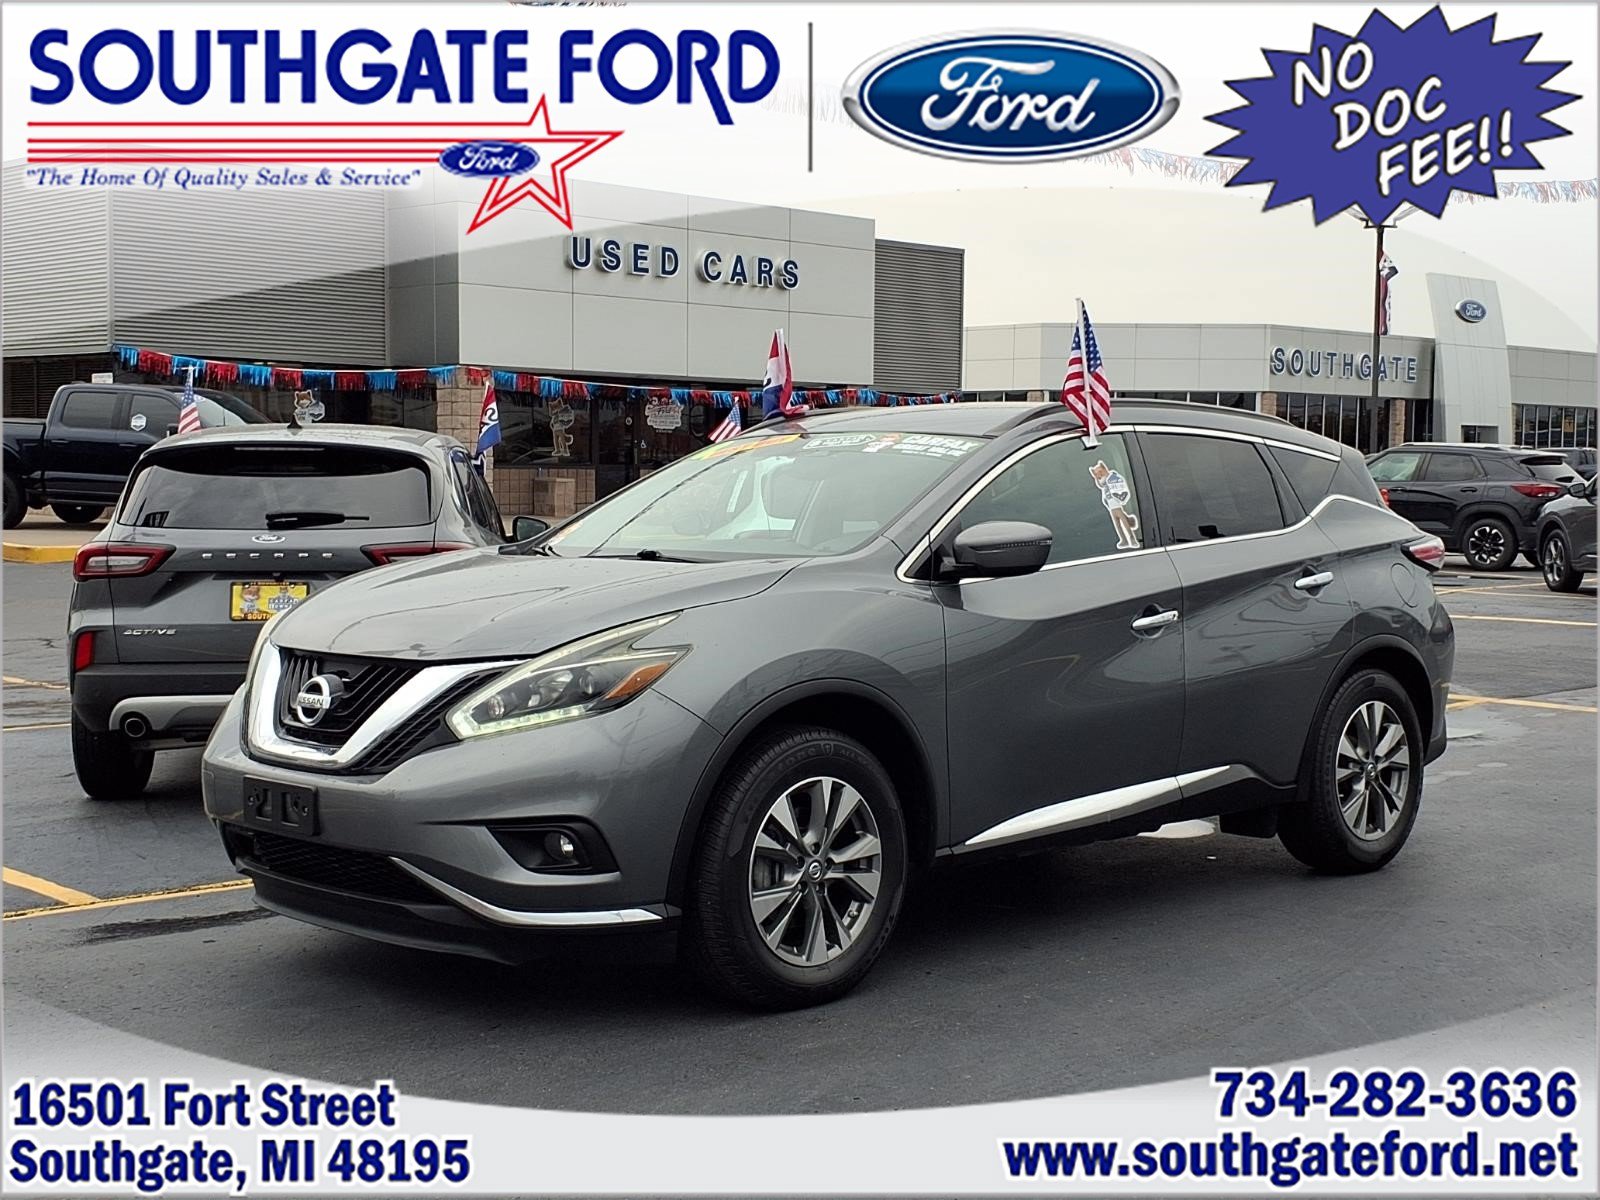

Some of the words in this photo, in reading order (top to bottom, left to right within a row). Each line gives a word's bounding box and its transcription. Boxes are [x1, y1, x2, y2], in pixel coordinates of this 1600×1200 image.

[570, 235, 680, 278] USED
[700, 250, 799, 289] CARS
[1272, 346, 1417, 382] SOUTHGATE
